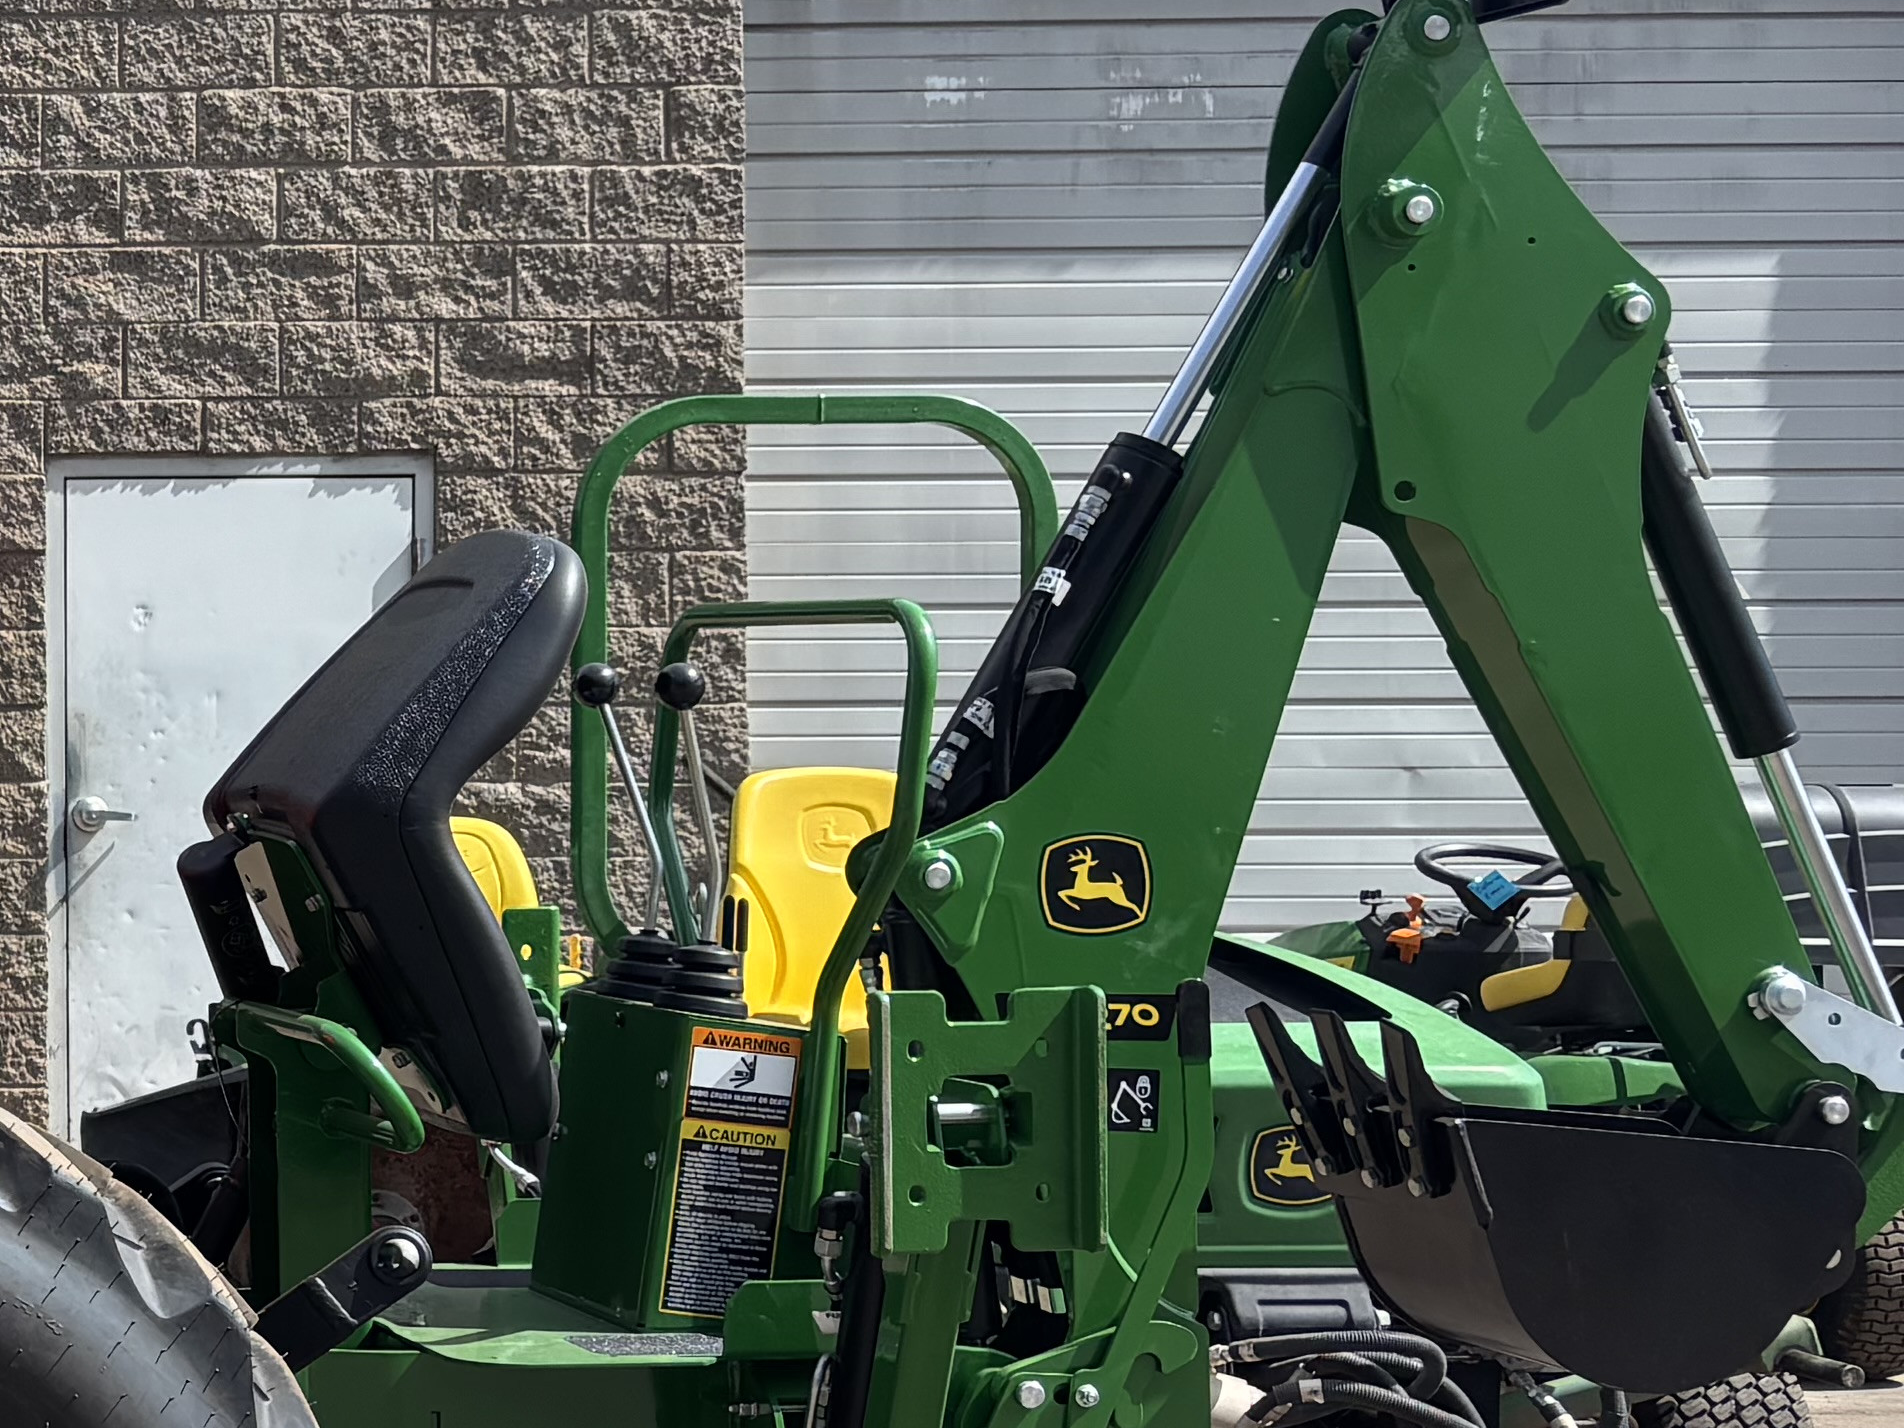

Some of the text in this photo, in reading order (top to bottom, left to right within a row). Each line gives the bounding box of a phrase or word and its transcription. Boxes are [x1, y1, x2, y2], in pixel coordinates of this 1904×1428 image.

[1106, 1002, 1160, 1030] 70
[717, 1033, 791, 1054] WARNING
[708, 1128, 777, 1147] CAUTION
